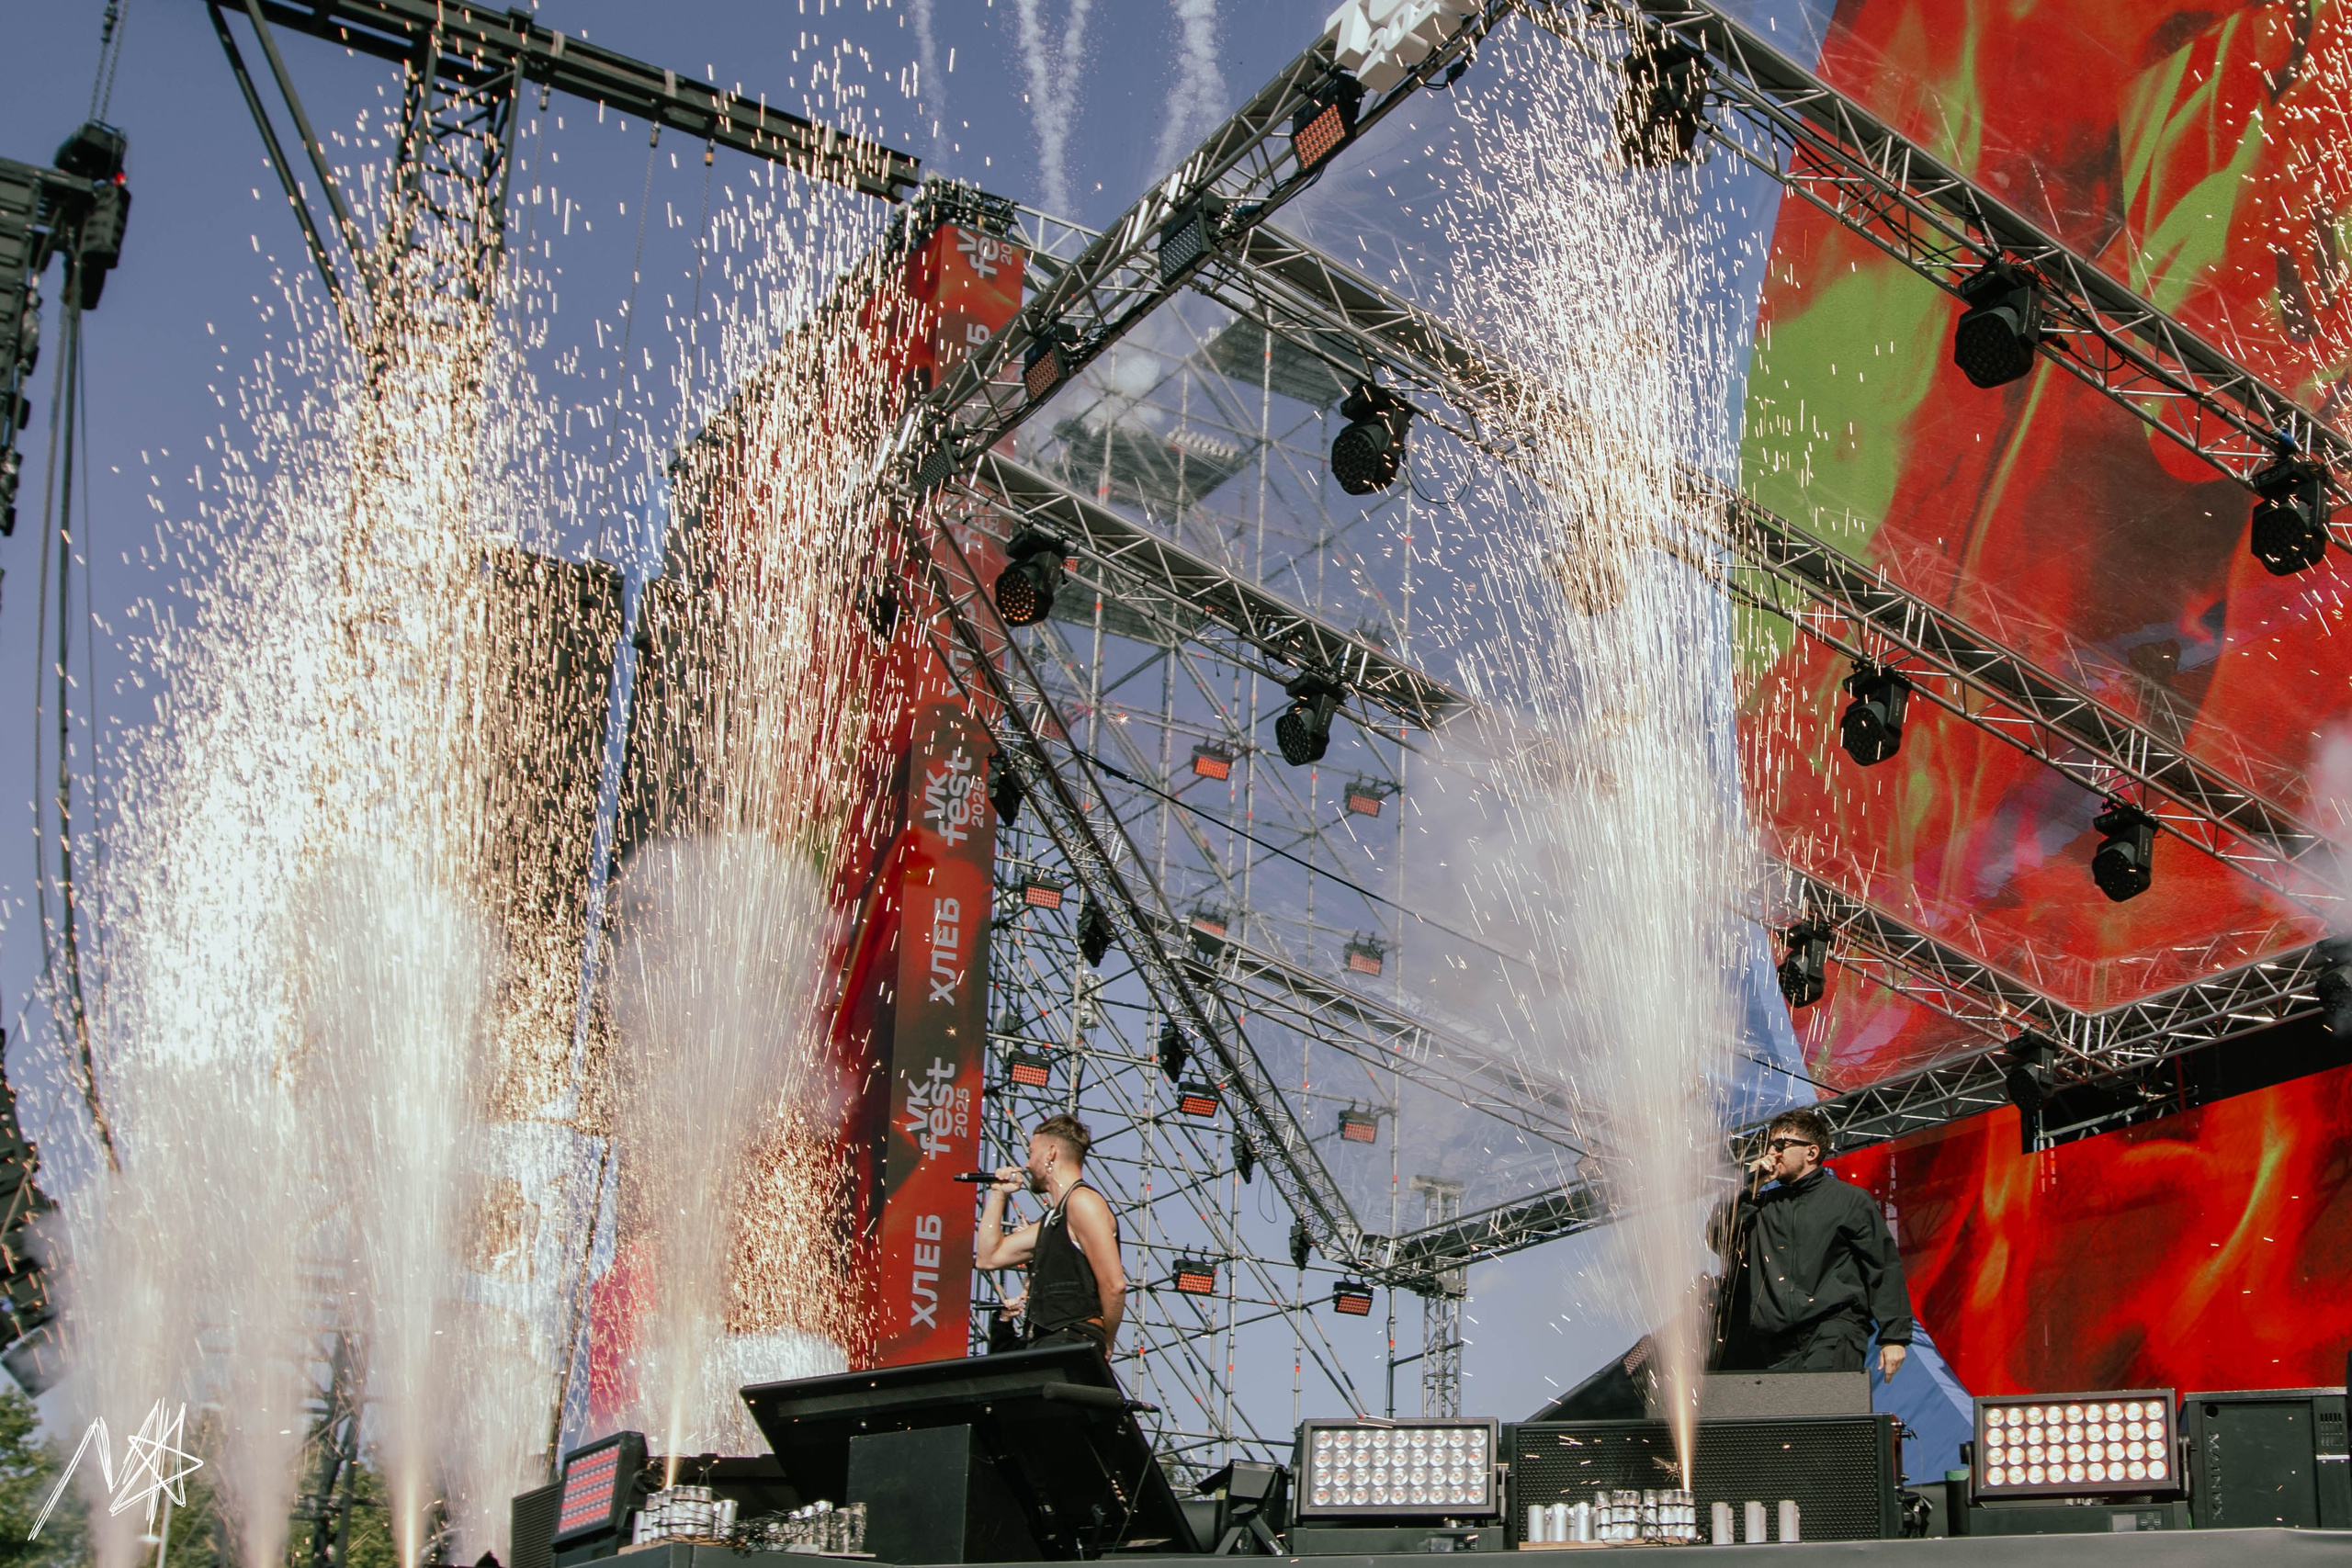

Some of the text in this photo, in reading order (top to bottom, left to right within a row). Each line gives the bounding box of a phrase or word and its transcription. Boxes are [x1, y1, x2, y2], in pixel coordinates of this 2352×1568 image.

[924, 769, 947, 819] VK
[939, 750, 972, 846] fest
[971, 780, 986, 829] 2025
[930, 897, 960, 1006] ХЛЕБ
[906, 1078, 931, 1132] VK
[919, 1057, 956, 1160] fest
[955, 1088, 970, 1138] 2025
[910, 1214, 942, 1329] ХЛЕБ
